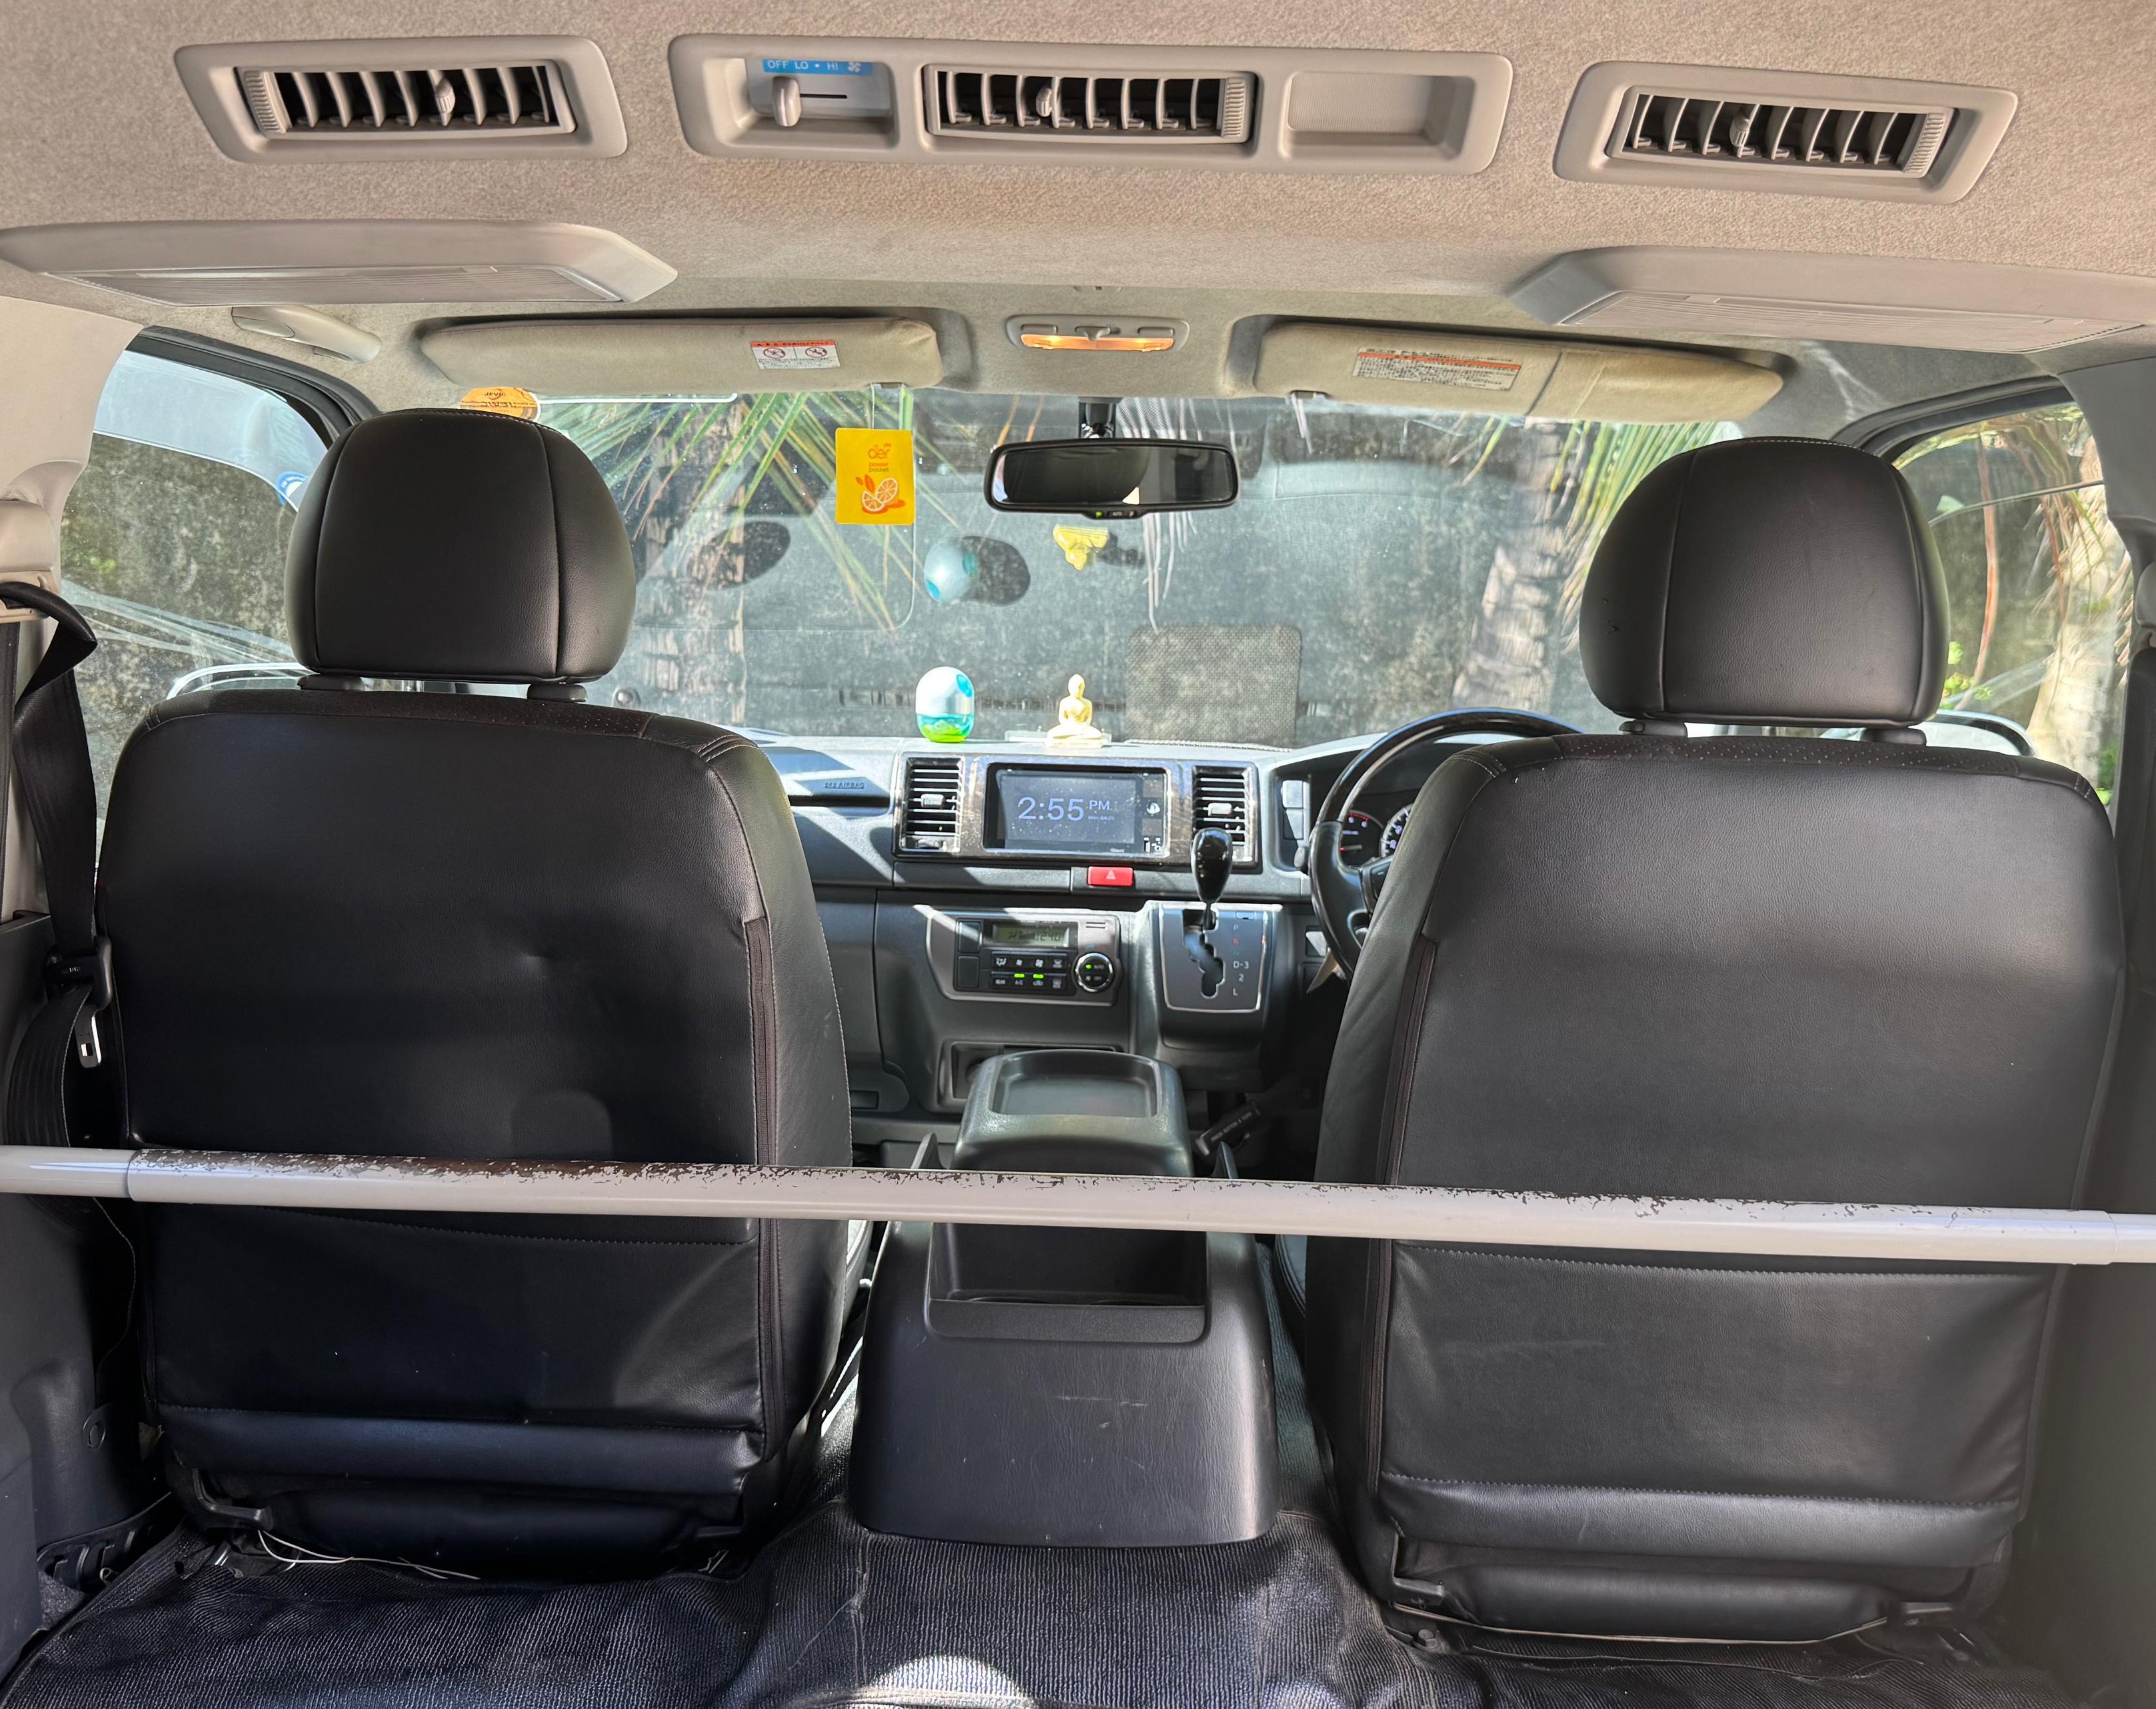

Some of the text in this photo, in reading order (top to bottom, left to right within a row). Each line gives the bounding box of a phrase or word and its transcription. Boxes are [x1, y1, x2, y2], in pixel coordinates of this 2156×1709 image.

[767, 59, 789, 69] OFF
[794, 61, 809, 70] LO
[1018, 796, 1110, 822] 2:55 PM
[1233, 960, 1250, 969] D-3
[1238, 973, 1244, 983] 2
